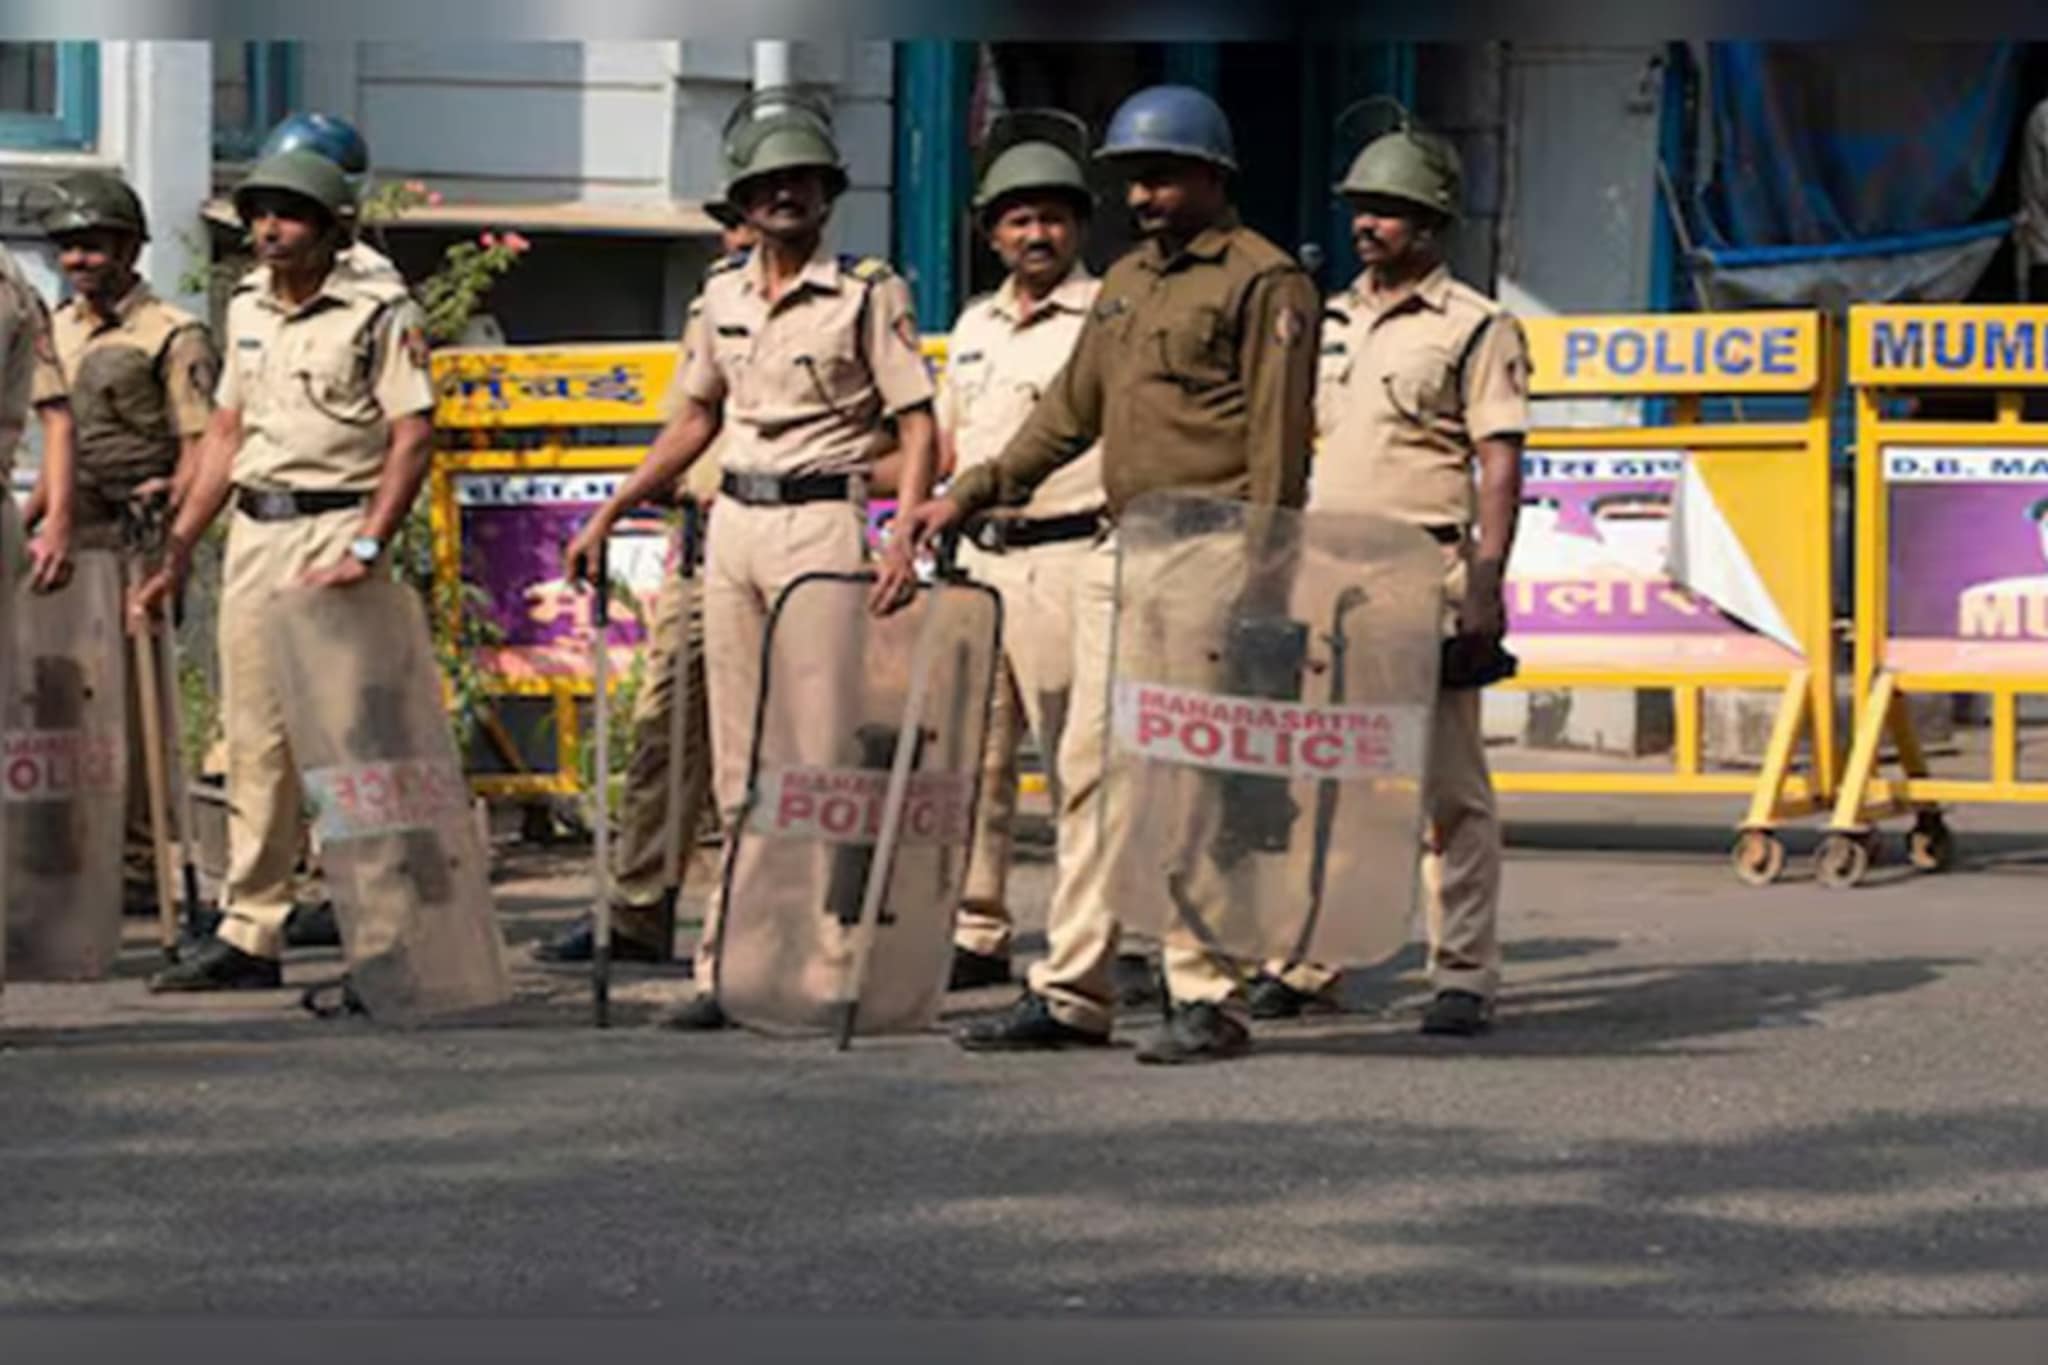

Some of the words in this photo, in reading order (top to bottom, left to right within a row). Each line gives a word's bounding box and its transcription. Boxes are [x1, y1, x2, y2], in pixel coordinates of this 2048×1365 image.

[1564, 328, 1798, 376] POLICE
[1872, 320, 2048, 371] MUM
[1138, 709, 1391, 768] POLICE
[776, 793, 964, 837] POLCE
